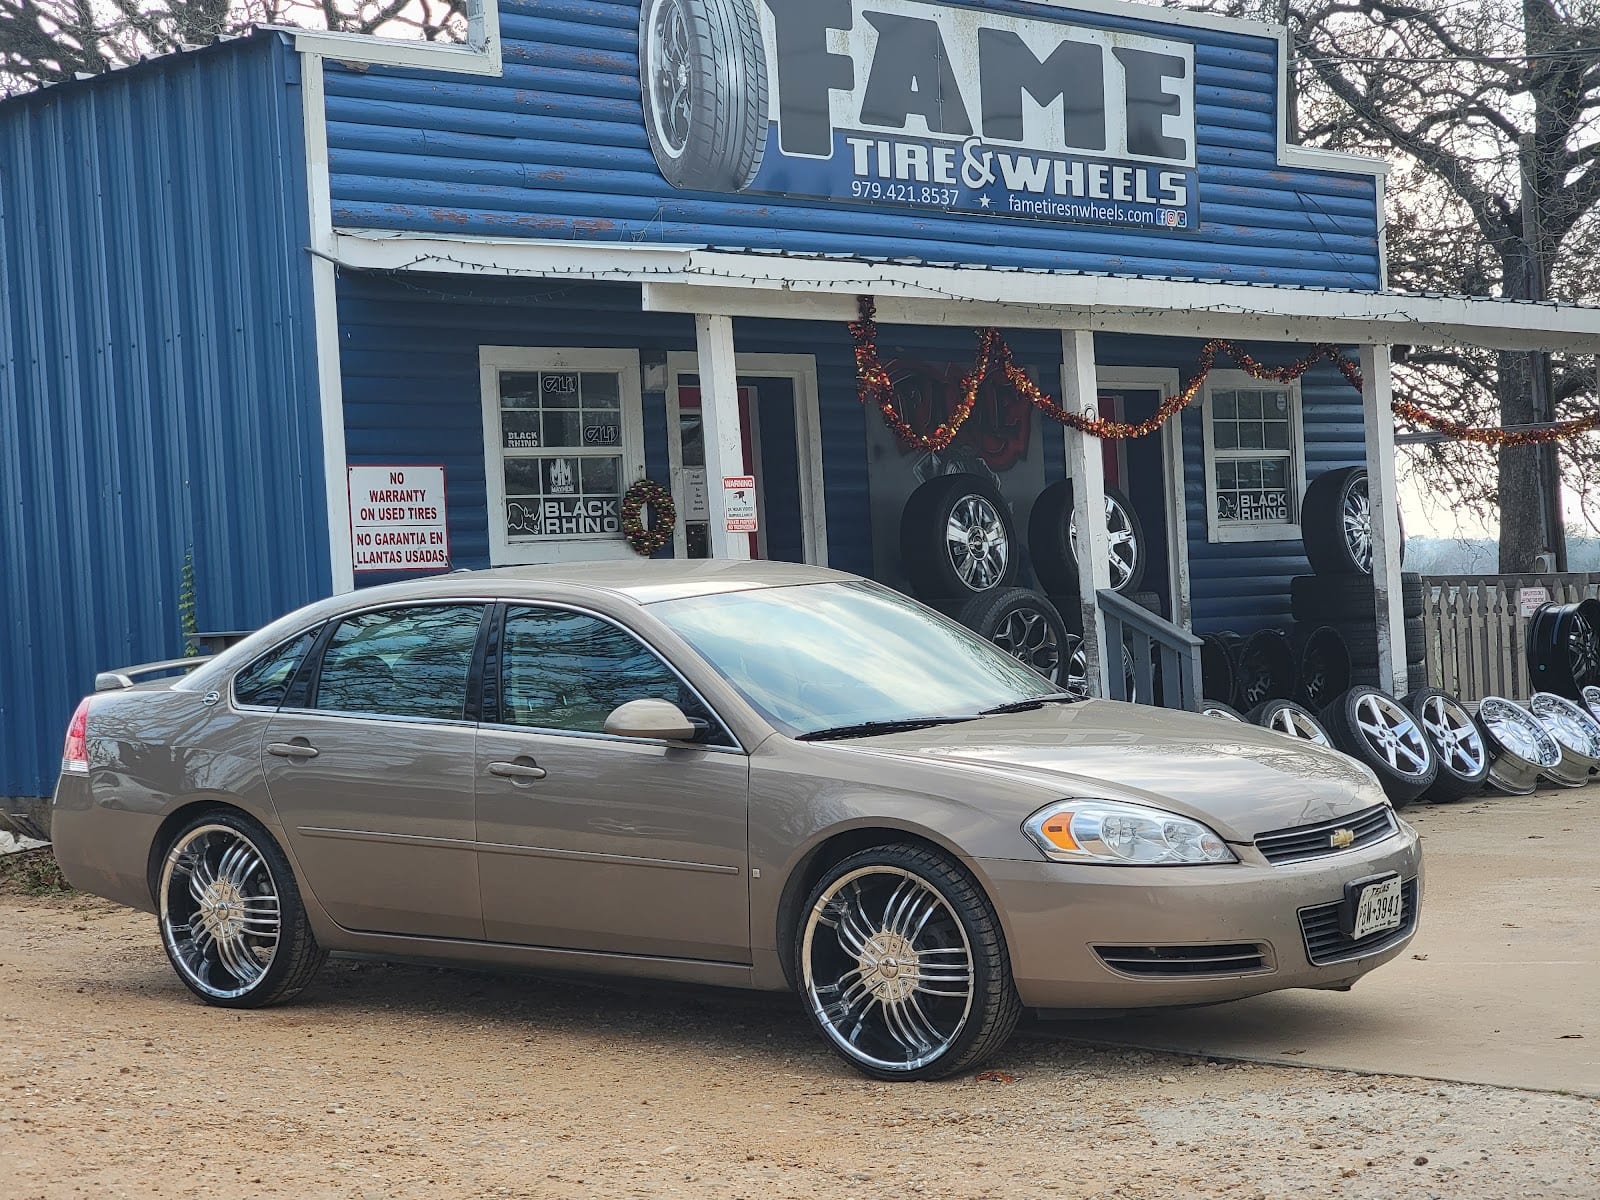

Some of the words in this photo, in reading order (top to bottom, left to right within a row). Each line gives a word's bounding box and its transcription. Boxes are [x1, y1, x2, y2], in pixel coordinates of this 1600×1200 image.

[757, 0, 1187, 161] FAME
[847, 138, 957, 185] TIRE
[961, 136, 996, 190] &
[997, 153, 1187, 207] WHEELS
[851, 181, 959, 206] 979.421.8537
[1008, 194, 1154, 224] fametiresnwheels.com
[508, 431, 538, 440] BLACK
[389, 472, 405, 485] NO
[724, 480, 753, 489] WARNING
[369, 490, 426, 503] WARRANTY
[1240, 494, 1287, 507] BLACK
[360, 508, 375, 521] ON
[378, 508, 405, 521] USED
[408, 507, 437, 520] TIRES
[544, 501, 618, 518] BLACK
[1241, 507, 1288, 520] RHINO
[546, 517, 619, 534] RHINO
[356, 533, 371, 546] NO
[374, 532, 427, 546] GARANTIA
[429, 532, 443, 545] EN
[356, 551, 402, 564] LLANTAS
[405, 550, 445, 563] USADAS
[1372, 883, 1391, 896] TEXAS
